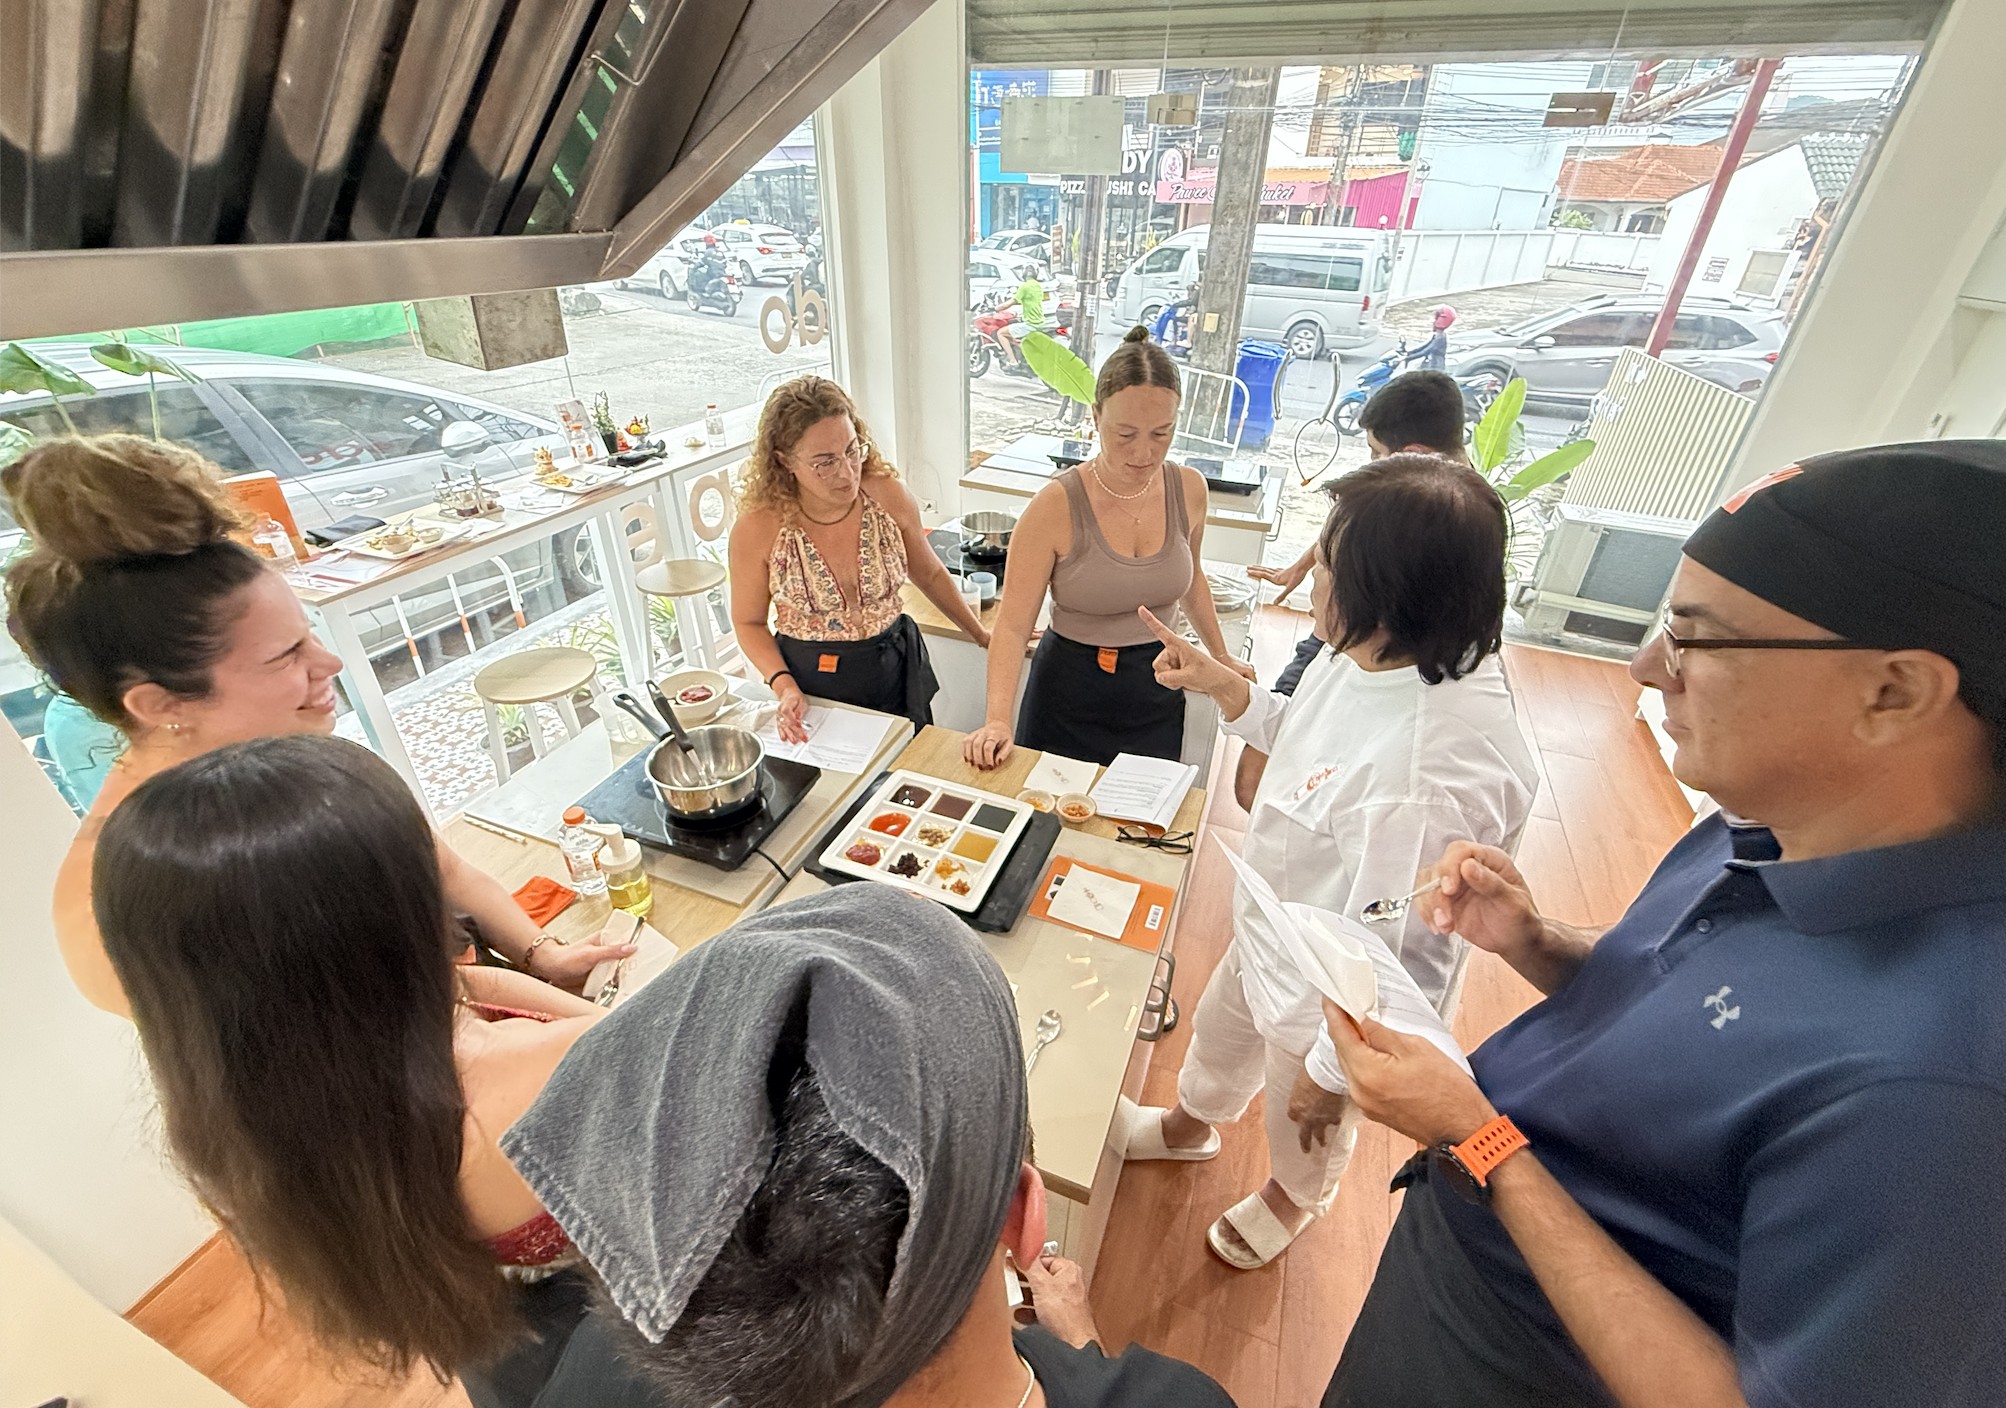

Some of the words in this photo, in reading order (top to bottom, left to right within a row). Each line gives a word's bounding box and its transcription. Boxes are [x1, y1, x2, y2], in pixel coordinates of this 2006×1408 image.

[1121, 149, 1153, 174] DY
[1060, 180, 1086, 194] PIZZ
[1137, 180, 1156, 195] CA
